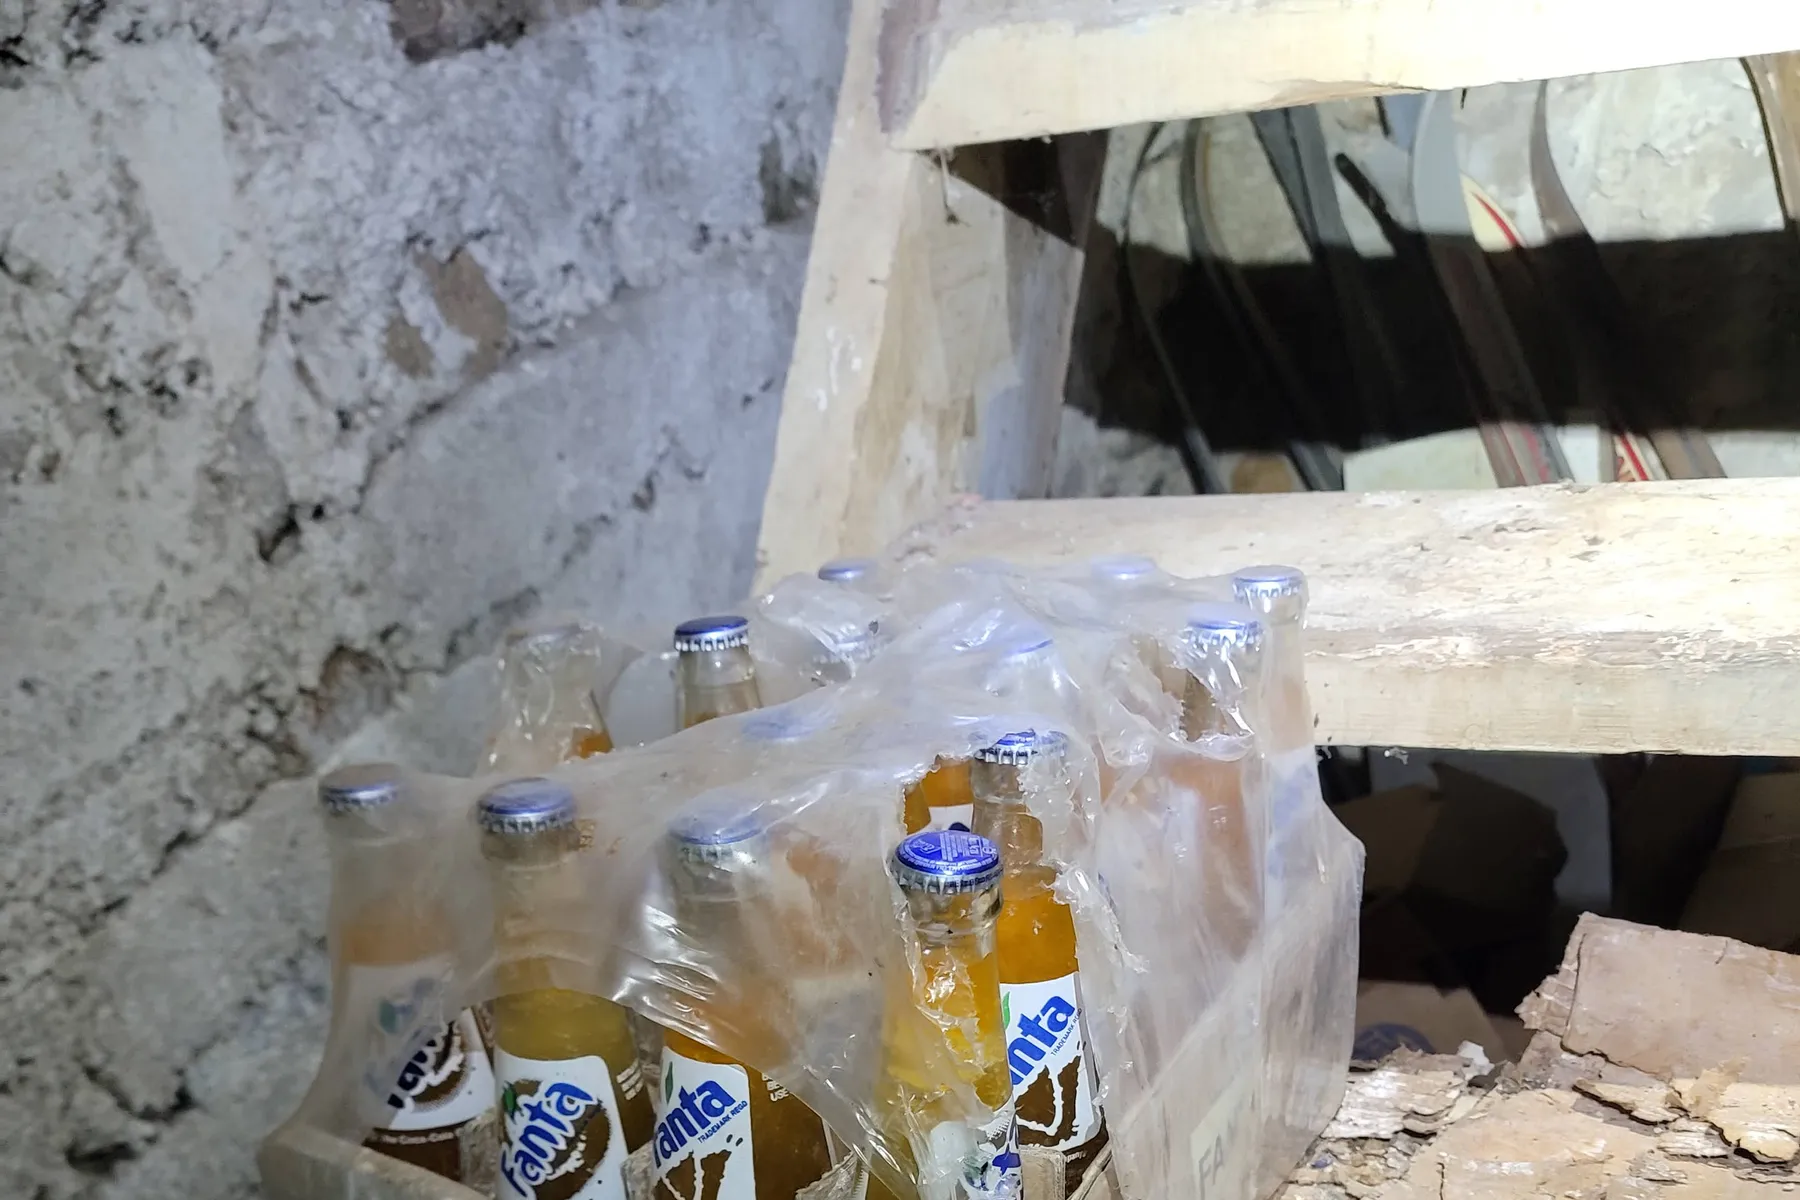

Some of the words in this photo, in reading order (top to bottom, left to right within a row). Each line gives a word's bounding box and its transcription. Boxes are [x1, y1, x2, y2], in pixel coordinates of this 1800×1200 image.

[1008, 995, 1076, 1086] nta
[501, 1082, 593, 1198] Fanta
[697, 1114, 731, 1144] TRADEMARK
